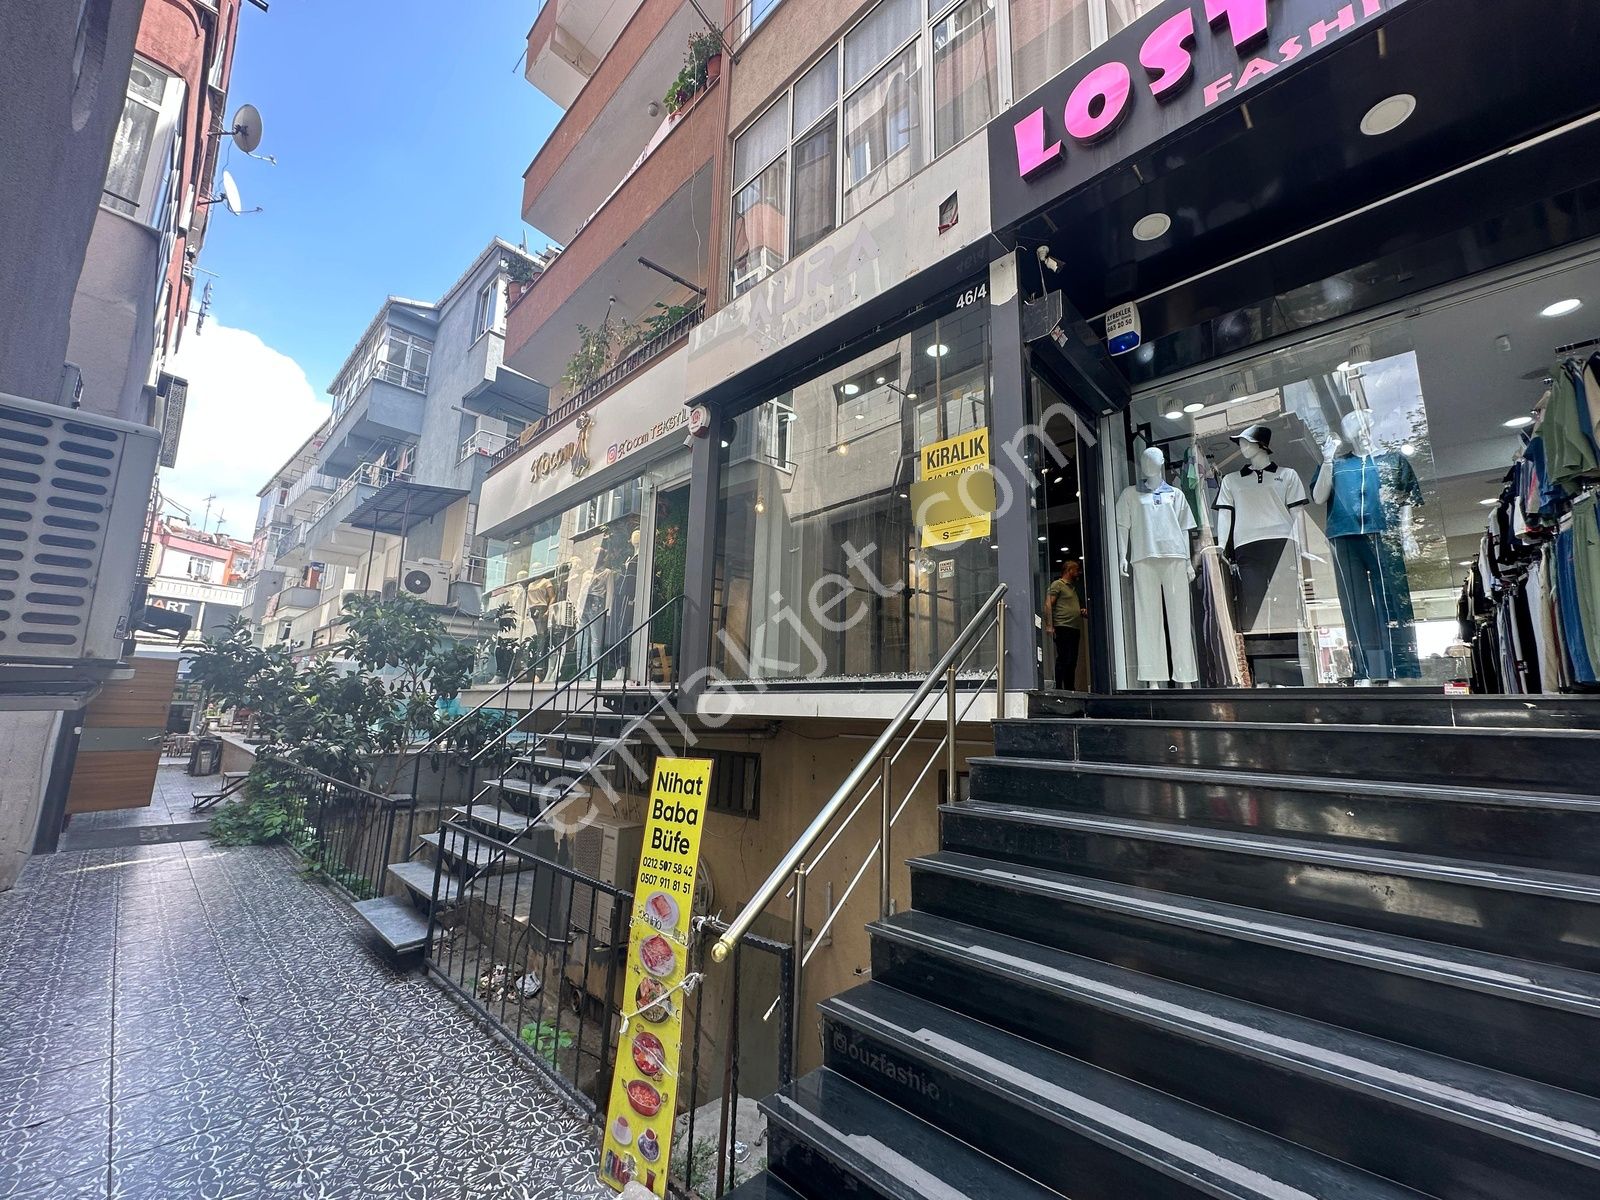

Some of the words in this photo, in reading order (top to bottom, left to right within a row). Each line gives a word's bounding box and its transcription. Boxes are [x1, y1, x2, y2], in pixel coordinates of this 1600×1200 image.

[956, 283, 987, 308] 46/4
[656, 771, 703, 796] Nihat
[652, 798, 699, 826] Baba
[651, 827, 690, 855] Büfe
[642, 856, 658, 869] 0212
[673, 863, 682, 875] 58
[683, 865, 693, 877] 42
[640, 872, 657, 886] 0507
[660, 876, 670, 889] 911
[672, 879, 681, 892] 81
[683, 882, 691, 895] 51
